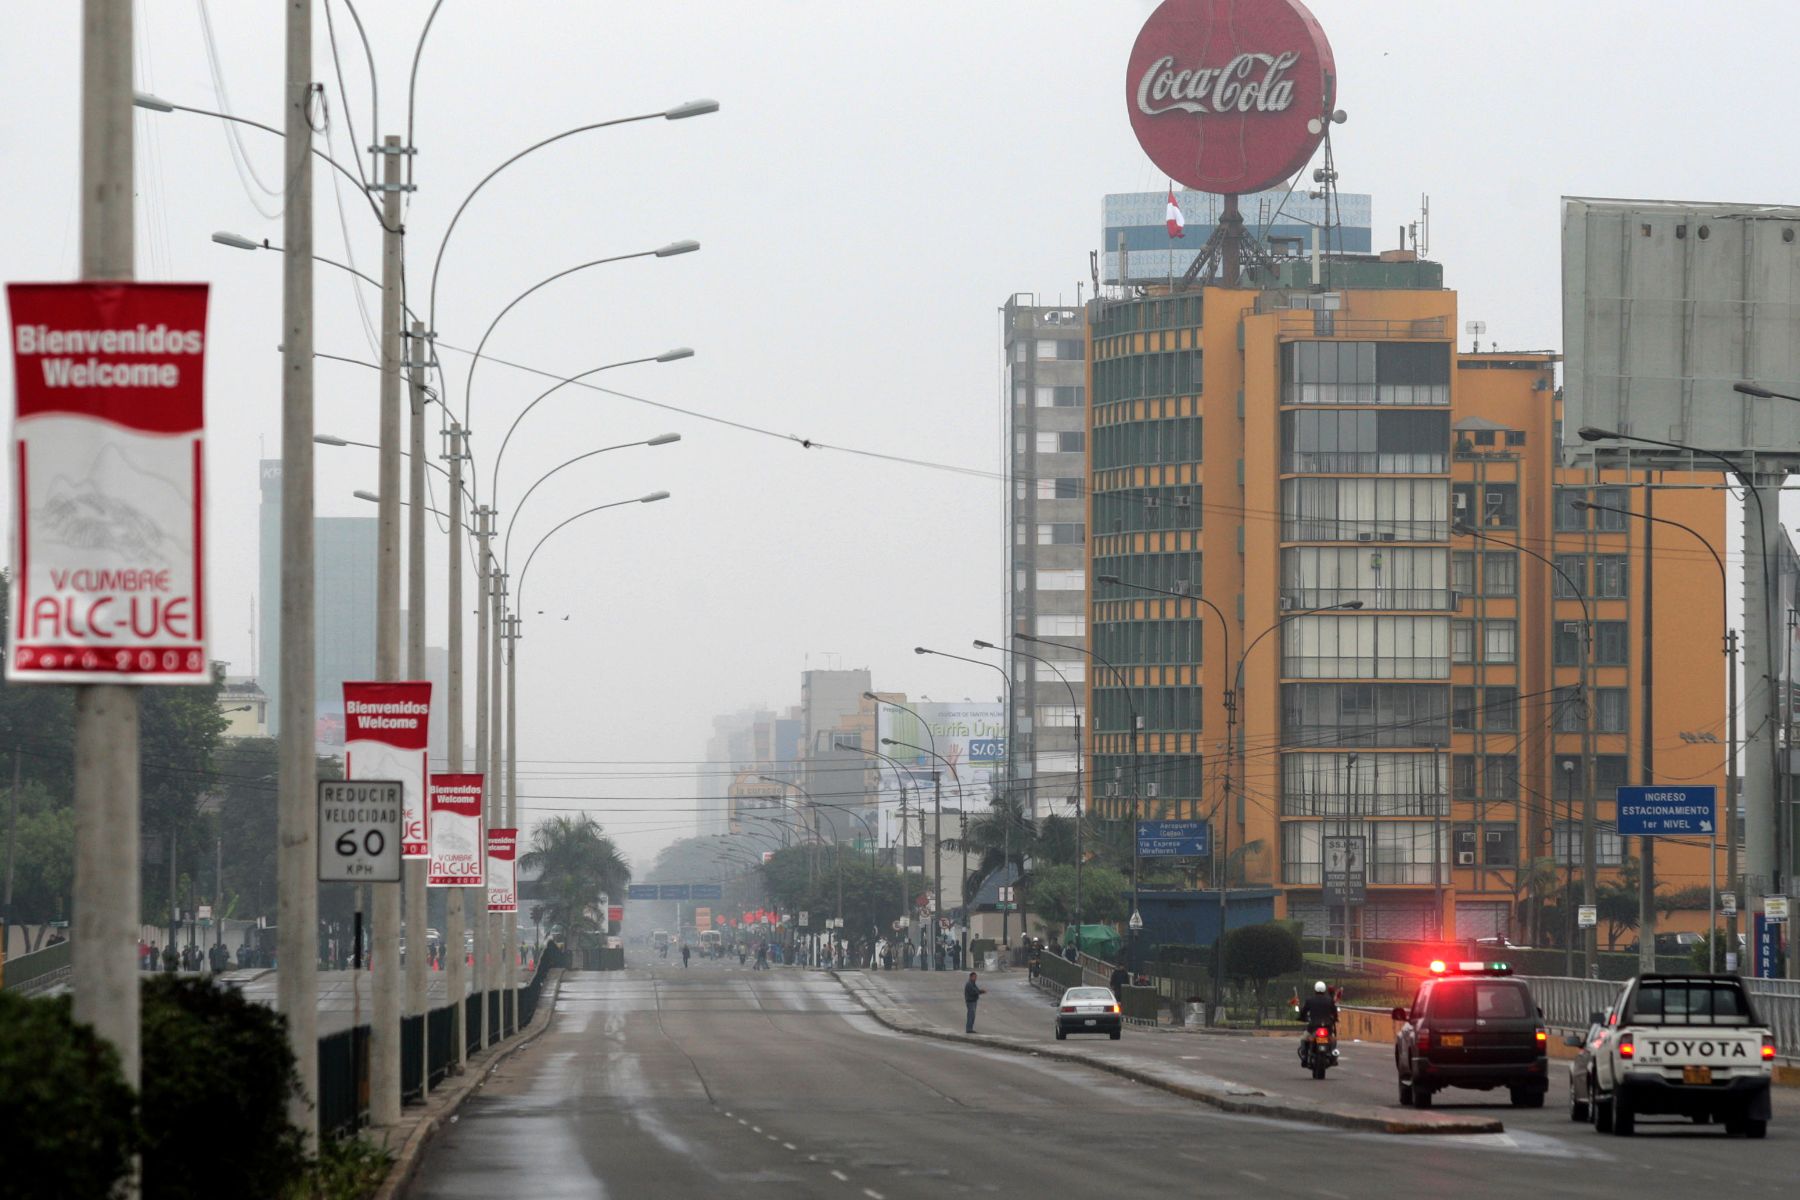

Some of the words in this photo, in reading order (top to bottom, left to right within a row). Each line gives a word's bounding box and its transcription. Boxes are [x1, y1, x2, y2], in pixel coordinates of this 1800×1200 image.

[1136, 51, 1300, 115] Coca-Cola
[16, 324, 203, 354] Bienvenidos
[41, 358, 180, 388] Welcome
[71, 568, 172, 592] CUMBRE
[33, 597, 189, 638] ALC-UE
[115, 650, 201, 671] 2008
[346, 701, 428, 714] Bienvenidos
[357, 716, 418, 729] Welcome
[929, 721, 970, 737] Tarifa
[324, 787, 396, 802] REDUCIR
[430, 785, 481, 794] Bienvenidos
[1645, 792, 1686, 801] INGRESO
[437, 795, 475, 804] Welcome
[324, 808, 397, 823] VELOCIDAD
[1622, 806, 1710, 815] ESTACIONAMIENTO
[1643, 820, 1657, 829] 1er
[1663, 820, 1691, 829] NIVEL
[335, 828, 385, 857] 60
[346, 864, 373, 875] KPH
[433, 862, 478, 875] ALC-UE
[1648, 1041, 1747, 1057] TOYOTA
